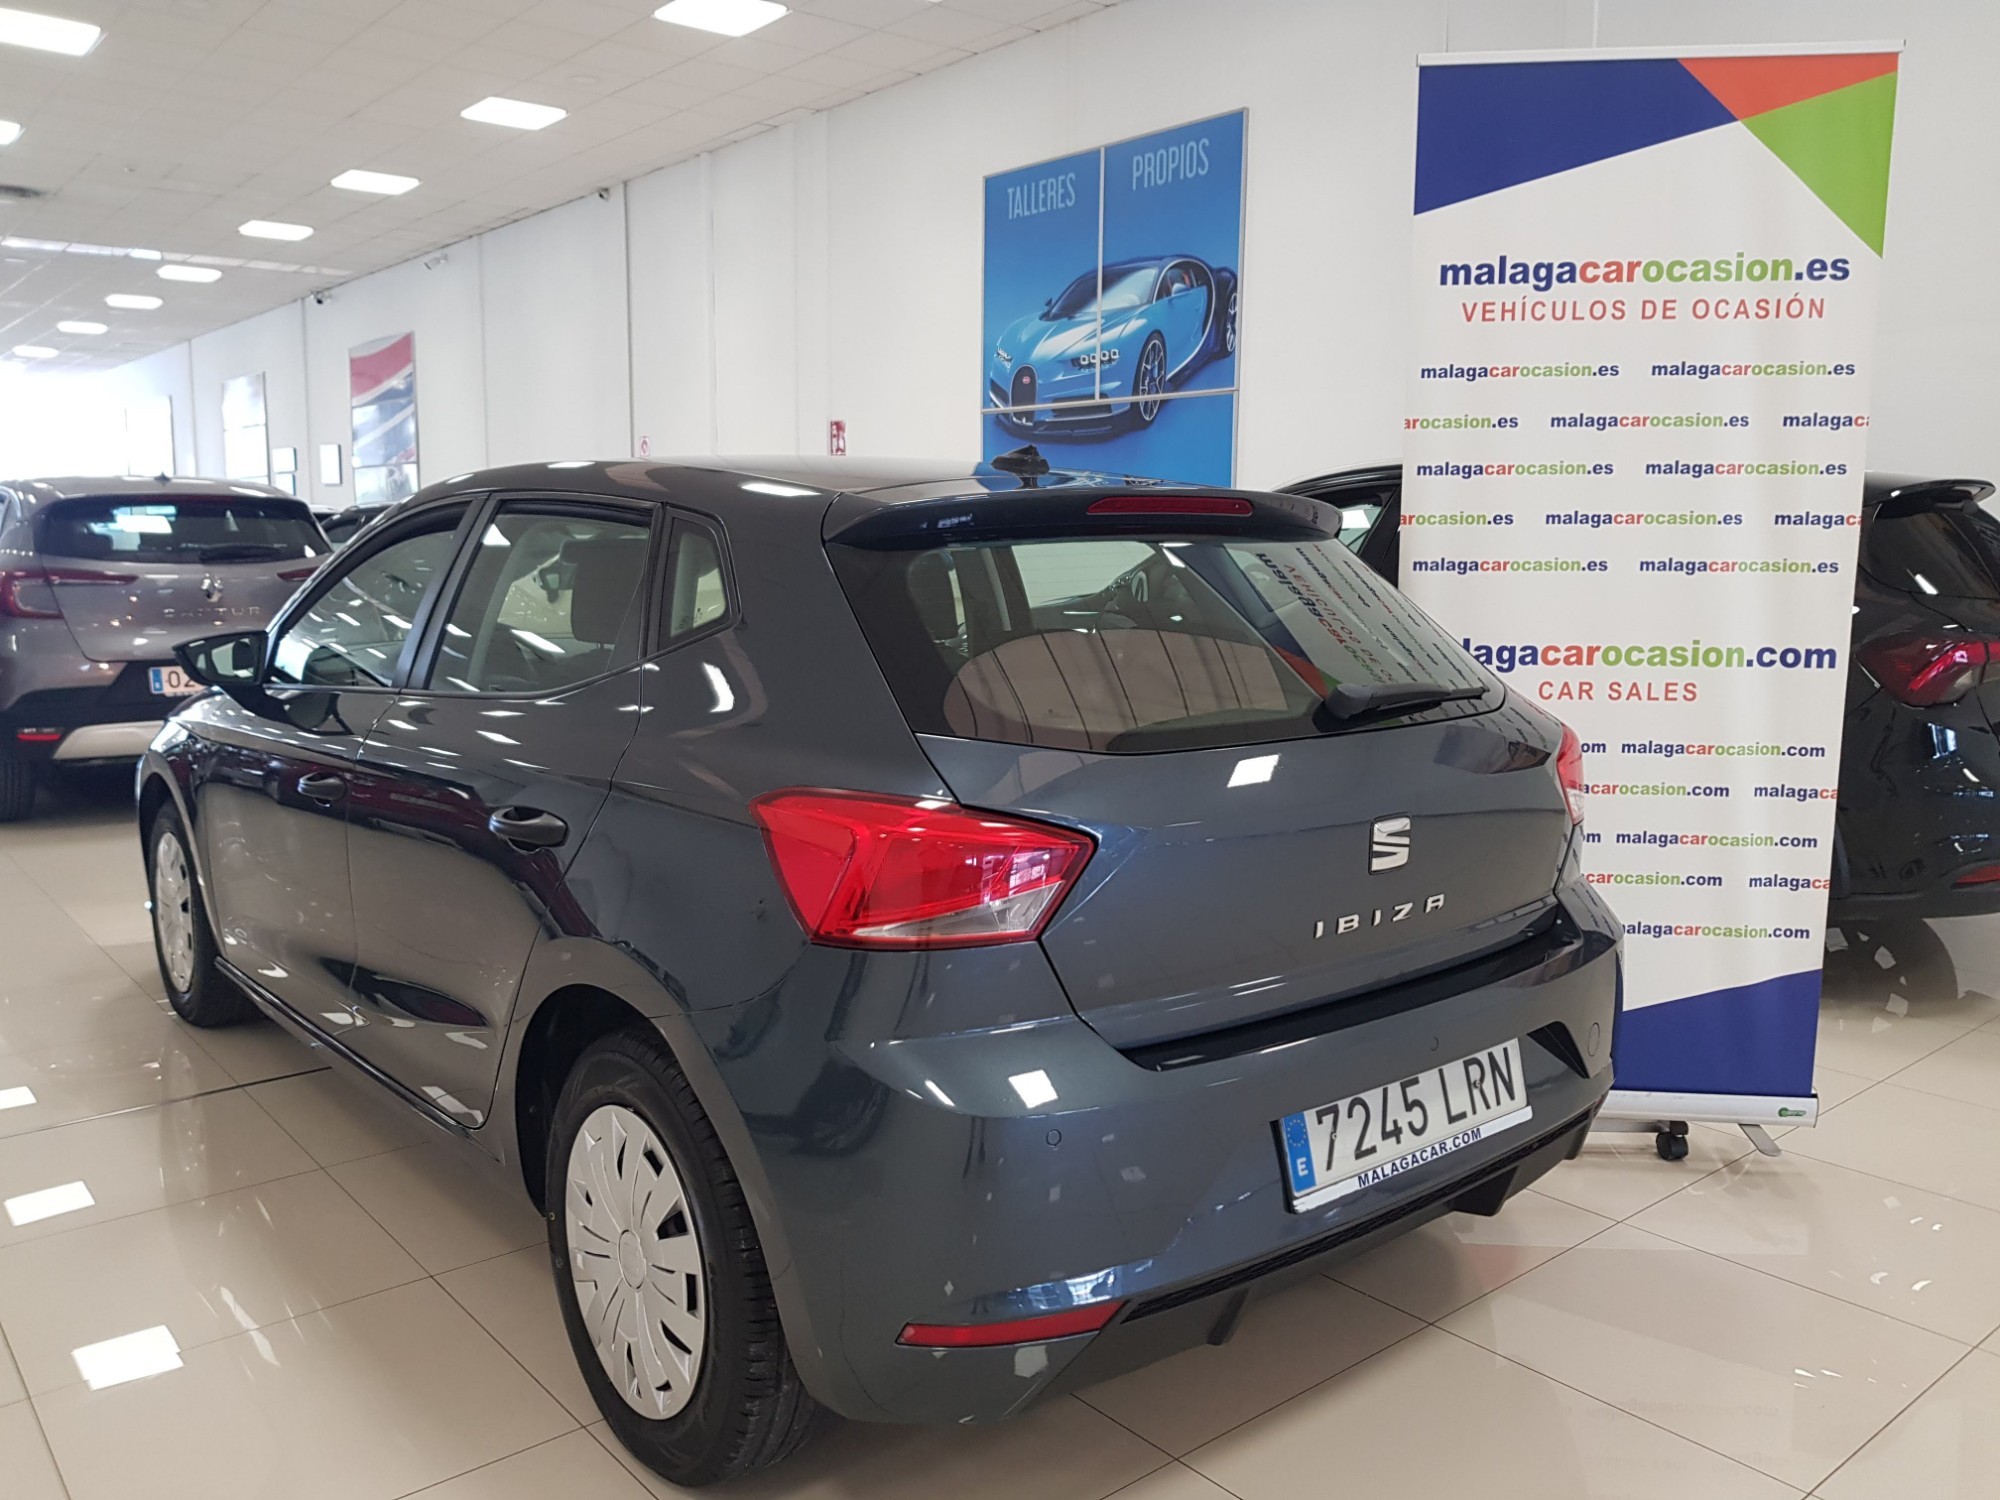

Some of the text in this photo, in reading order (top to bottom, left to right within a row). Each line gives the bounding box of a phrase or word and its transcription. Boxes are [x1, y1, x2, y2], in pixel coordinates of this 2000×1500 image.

[1008, 138, 1209, 220] TALLERES PROPIOS
[1439, 251, 1850, 292] malagacarocasion.es
[1462, 292, 1825, 322] VEHÍCULOS DE OCASIÓN
[1420, 362, 1619, 382] malagacarocasion.es
[1651, 360, 1855, 379] malagacarocasion.es
[1550, 412, 1749, 431] malagacarocasion.es
[1782, 412, 1869, 430] malagac
[1416, 461, 1613, 479] malagacarocasion.es
[1645, 460, 1847, 478] malagacarocasion.es
[1545, 510, 1743, 528] malagacarocasion.es
[1412, 557, 1608, 576] malagacarocasion.es
[1639, 557, 1839, 575] malagacarocasion.es
[1538, 681, 1698, 702] CAR SALES
[1621, 740, 1826, 758] malagacarocasion.com
[1616, 830, 1818, 848] malagacarocasion.com
[1582, 871, 1723, 887] carocasion.com
[1314, 894, 1445, 939] IBIZA
[1316, 1047, 1516, 1171] 7245 LRN
[1297, 1157, 1309, 1176] E
[1358, 1127, 1482, 1188] MALAGACAR.COM
